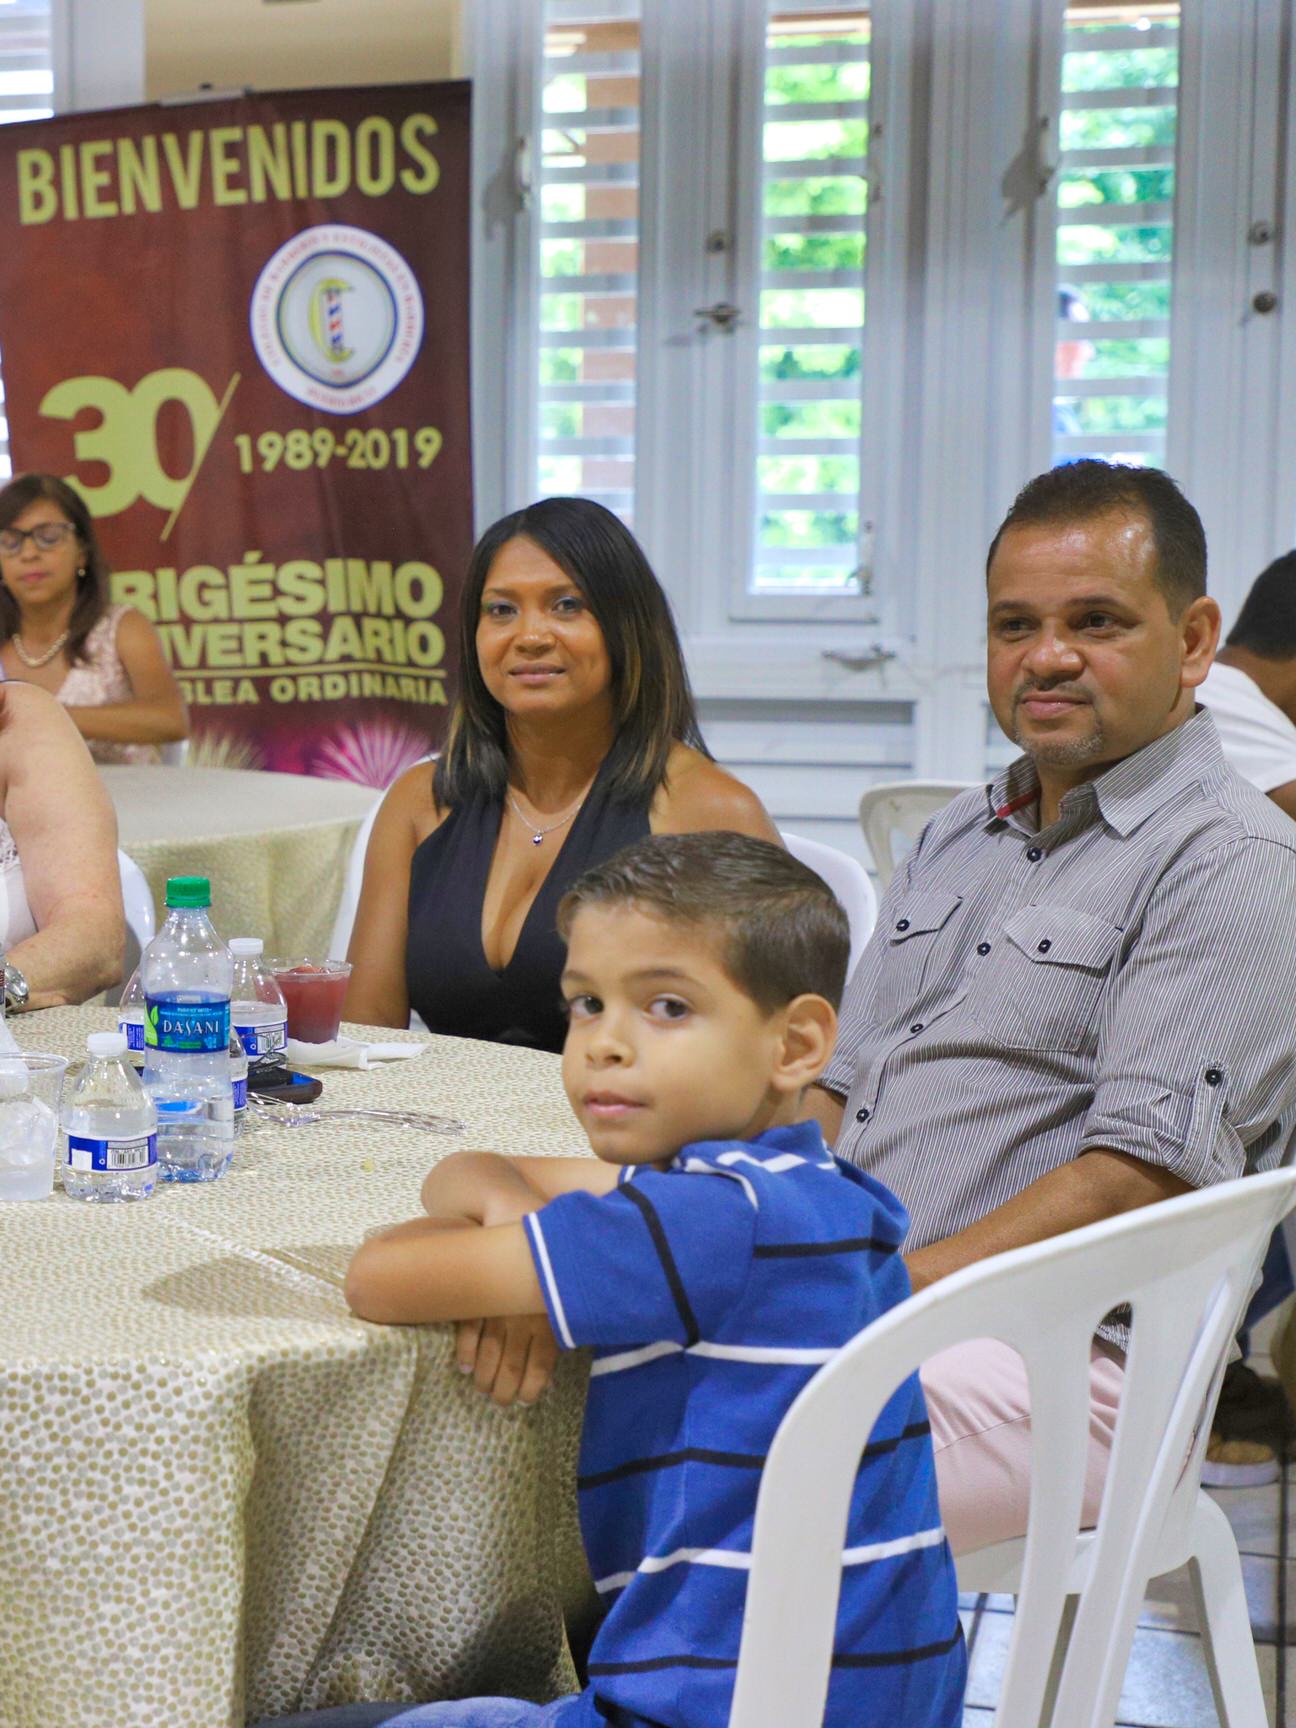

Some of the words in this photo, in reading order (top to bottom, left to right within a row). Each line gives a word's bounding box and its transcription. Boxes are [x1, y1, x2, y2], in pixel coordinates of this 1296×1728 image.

[16, 113, 441, 225] BIENVENIDOS
[234, 426, 443, 474] 1989-2019
[269, 671, 449, 705] ORDINARIA
[163, 1019, 220, 1035] DASANI
